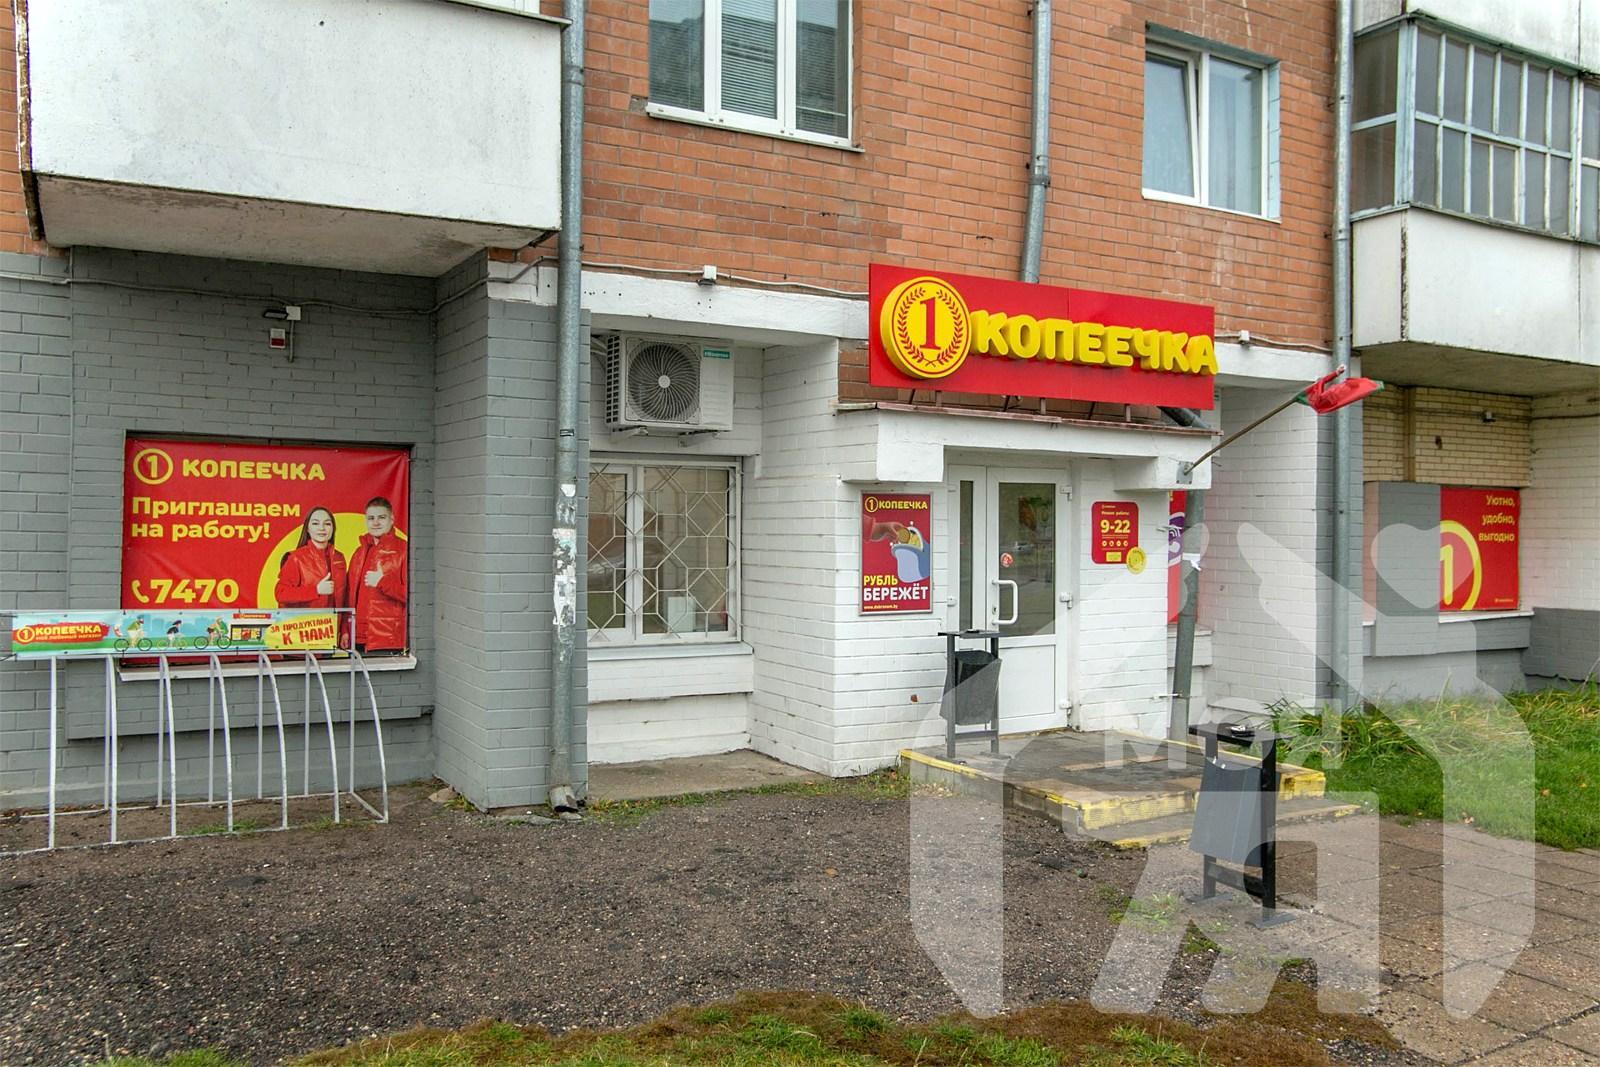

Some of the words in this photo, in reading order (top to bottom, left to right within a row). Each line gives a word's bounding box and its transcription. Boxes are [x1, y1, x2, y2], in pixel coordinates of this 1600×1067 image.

[919, 297, 941, 350] 1
[970, 310, 1219, 375] КОПЕЕЧКА
[147, 455, 158, 478] 1
[182, 458, 325, 481] КОПЕЕЧКА
[131, 497, 300, 518] Приглашаем
[869, 499, 874, 510] 1
[879, 500, 928, 510] КОПЕЕЧКА
[1486, 495, 1515, 507] Уютно,
[1100, 519, 1131, 534] 9-22
[1482, 513, 1515, 525] удобно,
[131, 522, 164, 538] на
[172, 520, 270, 543] работу!
[1478, 532, 1515, 543] выгодно
[863, 575, 898, 586] РУБЛЬ
[150, 578, 239, 604] 7470
[863, 582, 929, 602] БЕРЕЖЁТ
[35, 624, 102, 636] КОПЕЕЧКА
[270, 623, 280, 634] ЗА
[283, 617, 332, 632] ПРОДУКТАМИ
[282, 632, 293, 645] К
[299, 625, 335, 643] НАМ!
